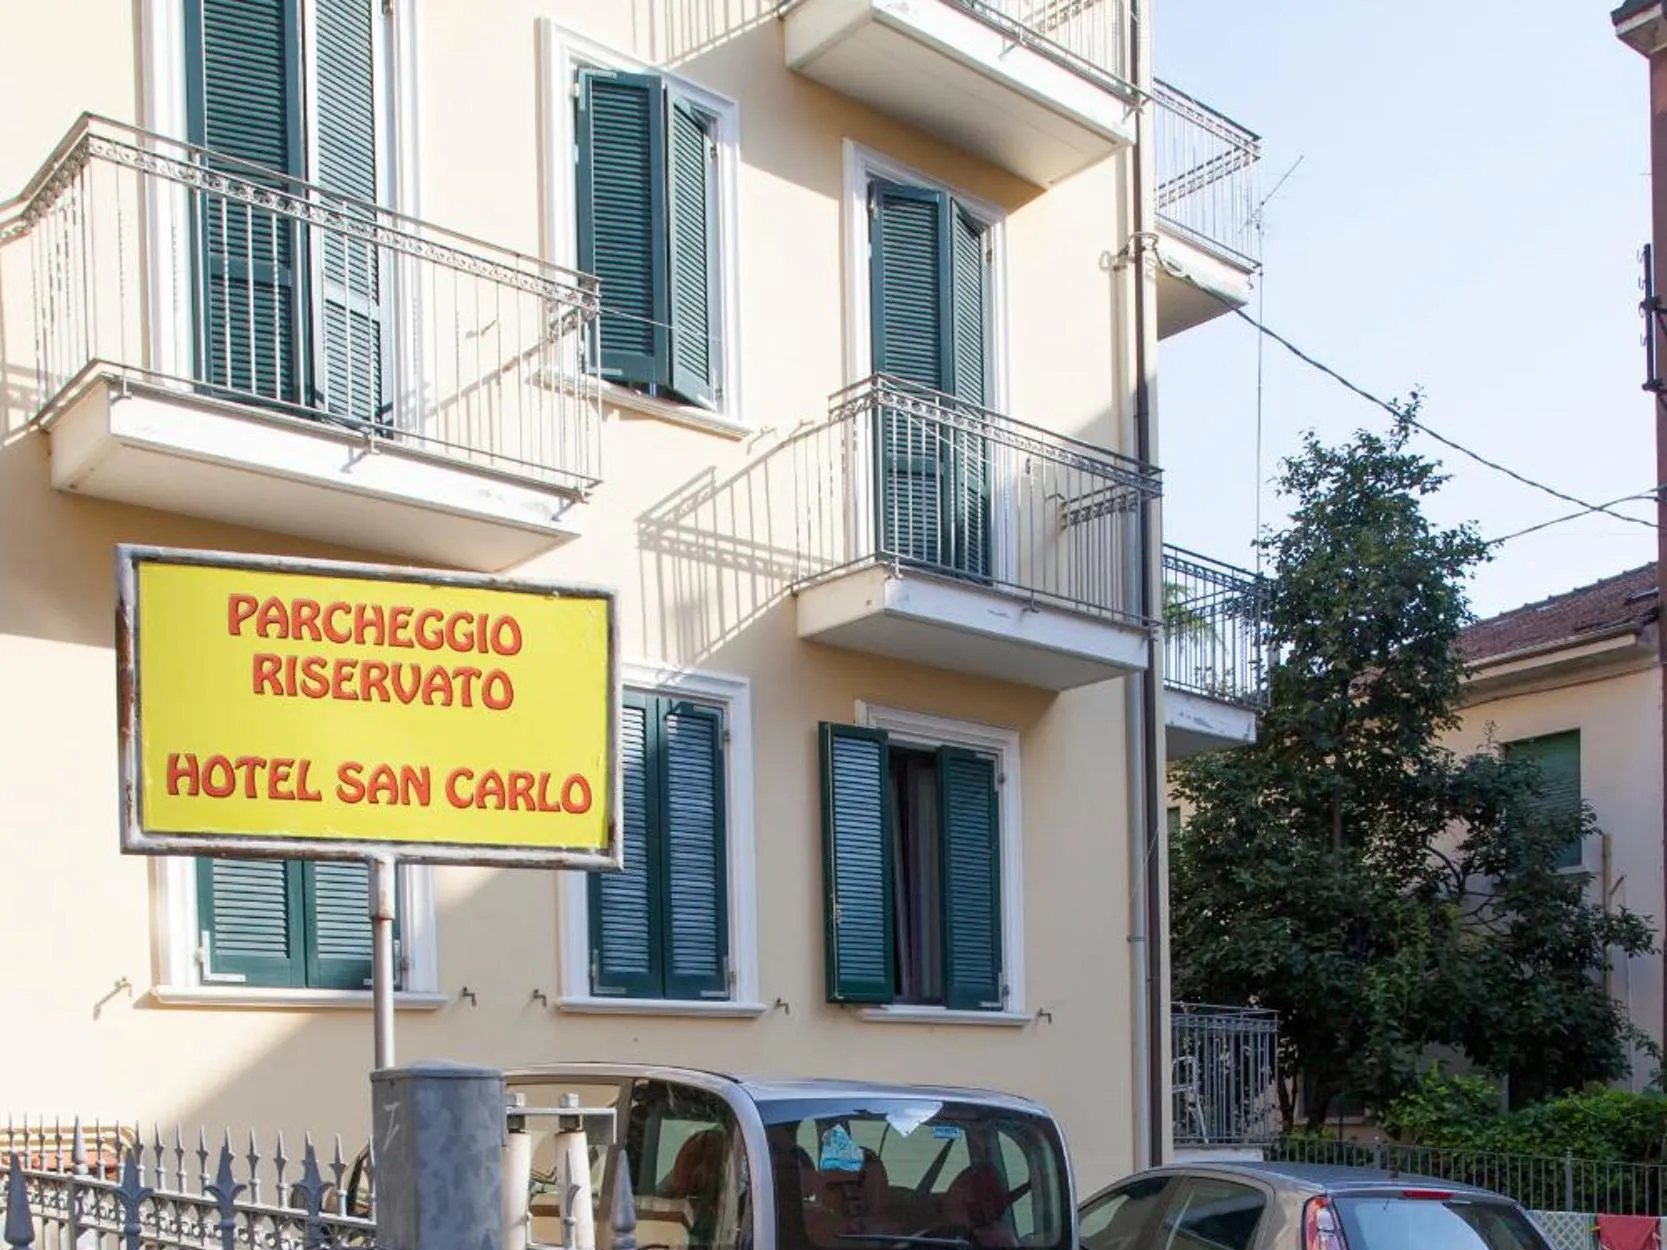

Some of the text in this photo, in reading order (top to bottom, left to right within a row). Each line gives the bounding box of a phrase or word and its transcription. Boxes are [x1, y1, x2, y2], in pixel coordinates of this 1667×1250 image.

[228, 594, 522, 655] PARCHEGGIO
[252, 653, 514, 710] RISERVATO
[167, 753, 592, 814] HOTEL SAN CARLO
